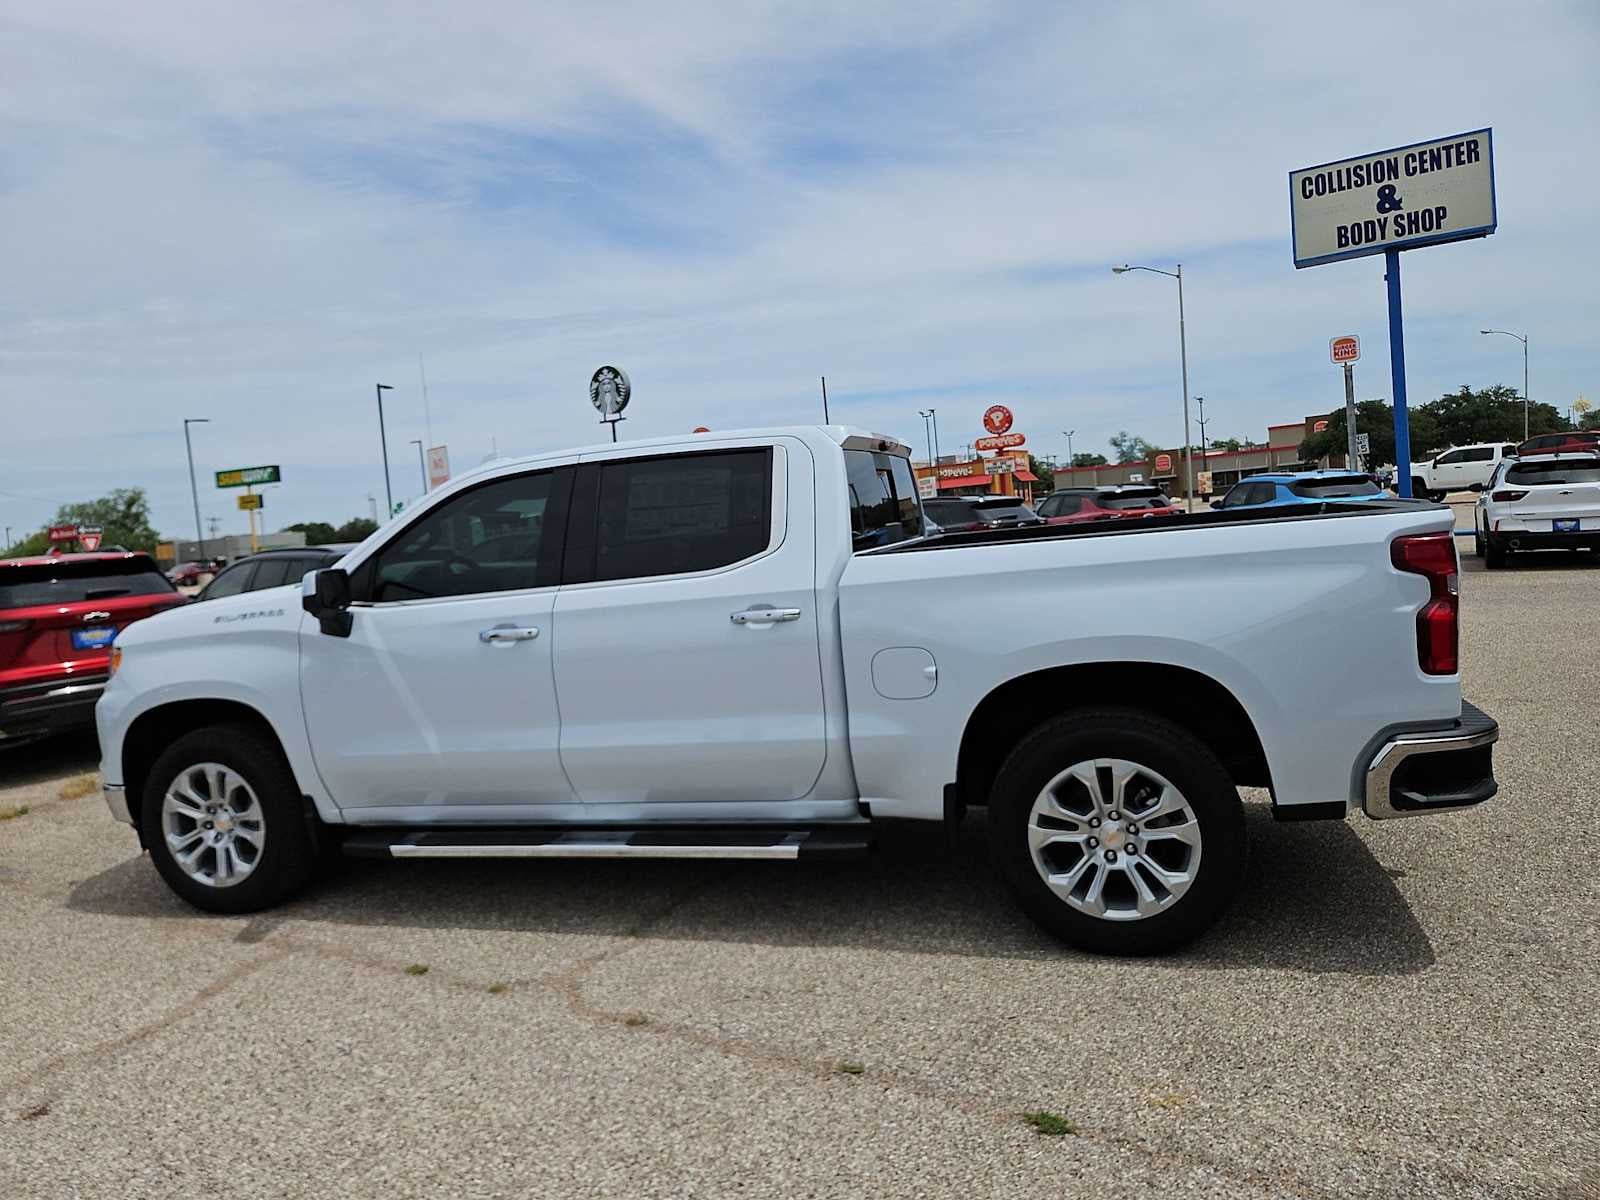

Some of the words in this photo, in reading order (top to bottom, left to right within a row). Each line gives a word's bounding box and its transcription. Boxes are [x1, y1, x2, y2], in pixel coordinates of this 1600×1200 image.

[1301, 157, 1400, 200] COLLISION
[1404, 138, 1480, 177] CENTER
[1376, 183, 1403, 214] &
[1336, 216, 1389, 249] BODY
[1393, 205, 1447, 238] SHOP
[1334, 349, 1357, 357] KING
